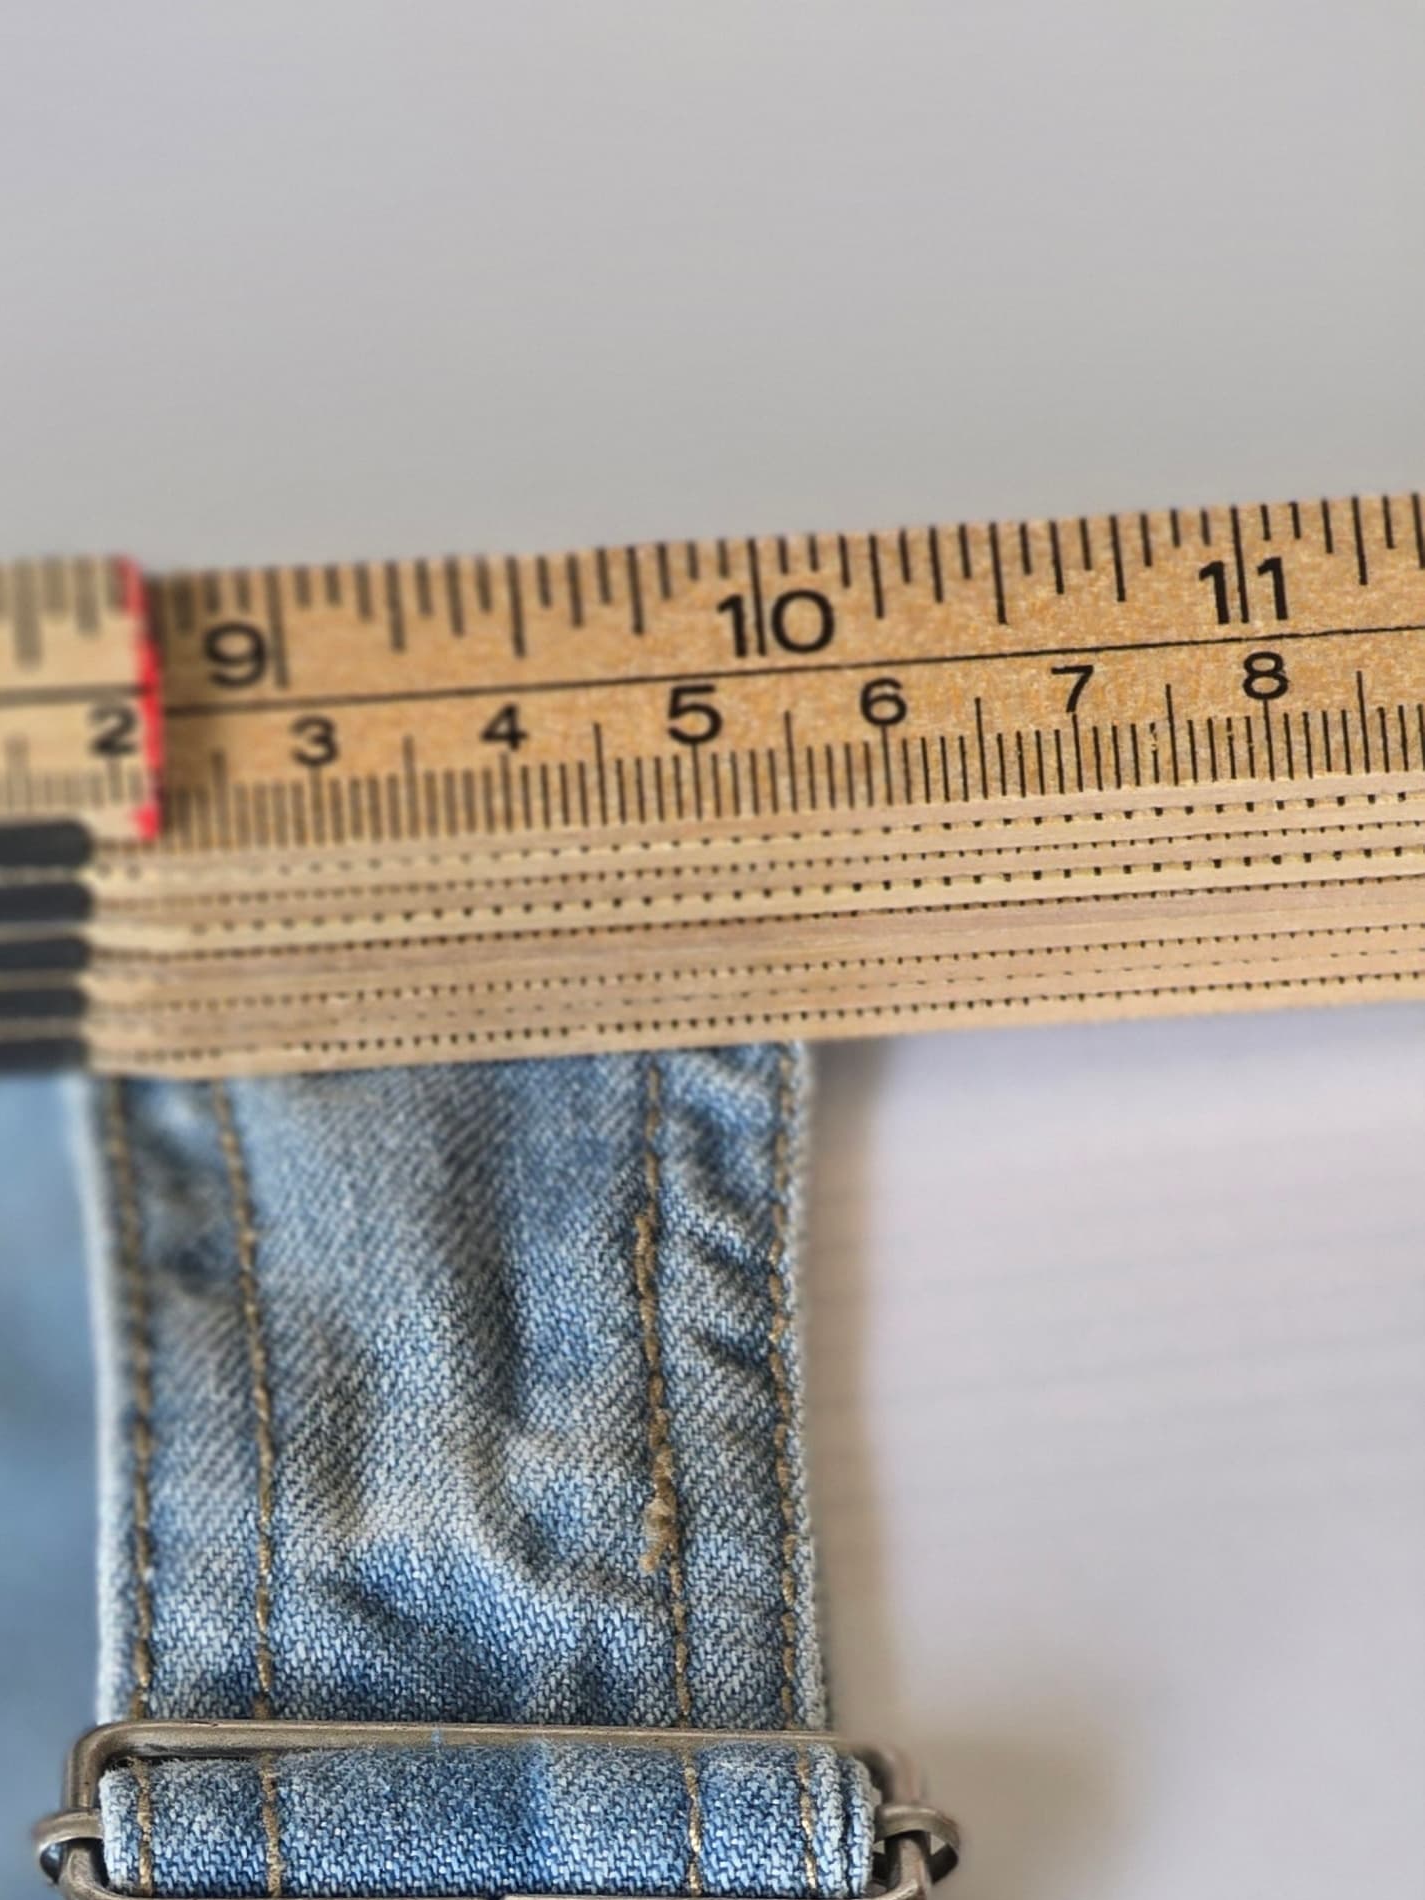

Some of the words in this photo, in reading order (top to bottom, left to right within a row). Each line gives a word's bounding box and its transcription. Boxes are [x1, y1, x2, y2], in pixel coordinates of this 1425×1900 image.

[202, 622, 268, 688] 9
[716, 588, 835, 658] 10
[1197, 556, 1289, 626] 11
[87, 703, 139, 757] 2
[291, 715, 339, 768] 3
[480, 704, 527, 752] 4
[667, 684, 723, 745] 5
[859, 677, 907, 727] 6
[1050, 664, 1094, 714] 7
[1243, 651, 1289, 702] 8
